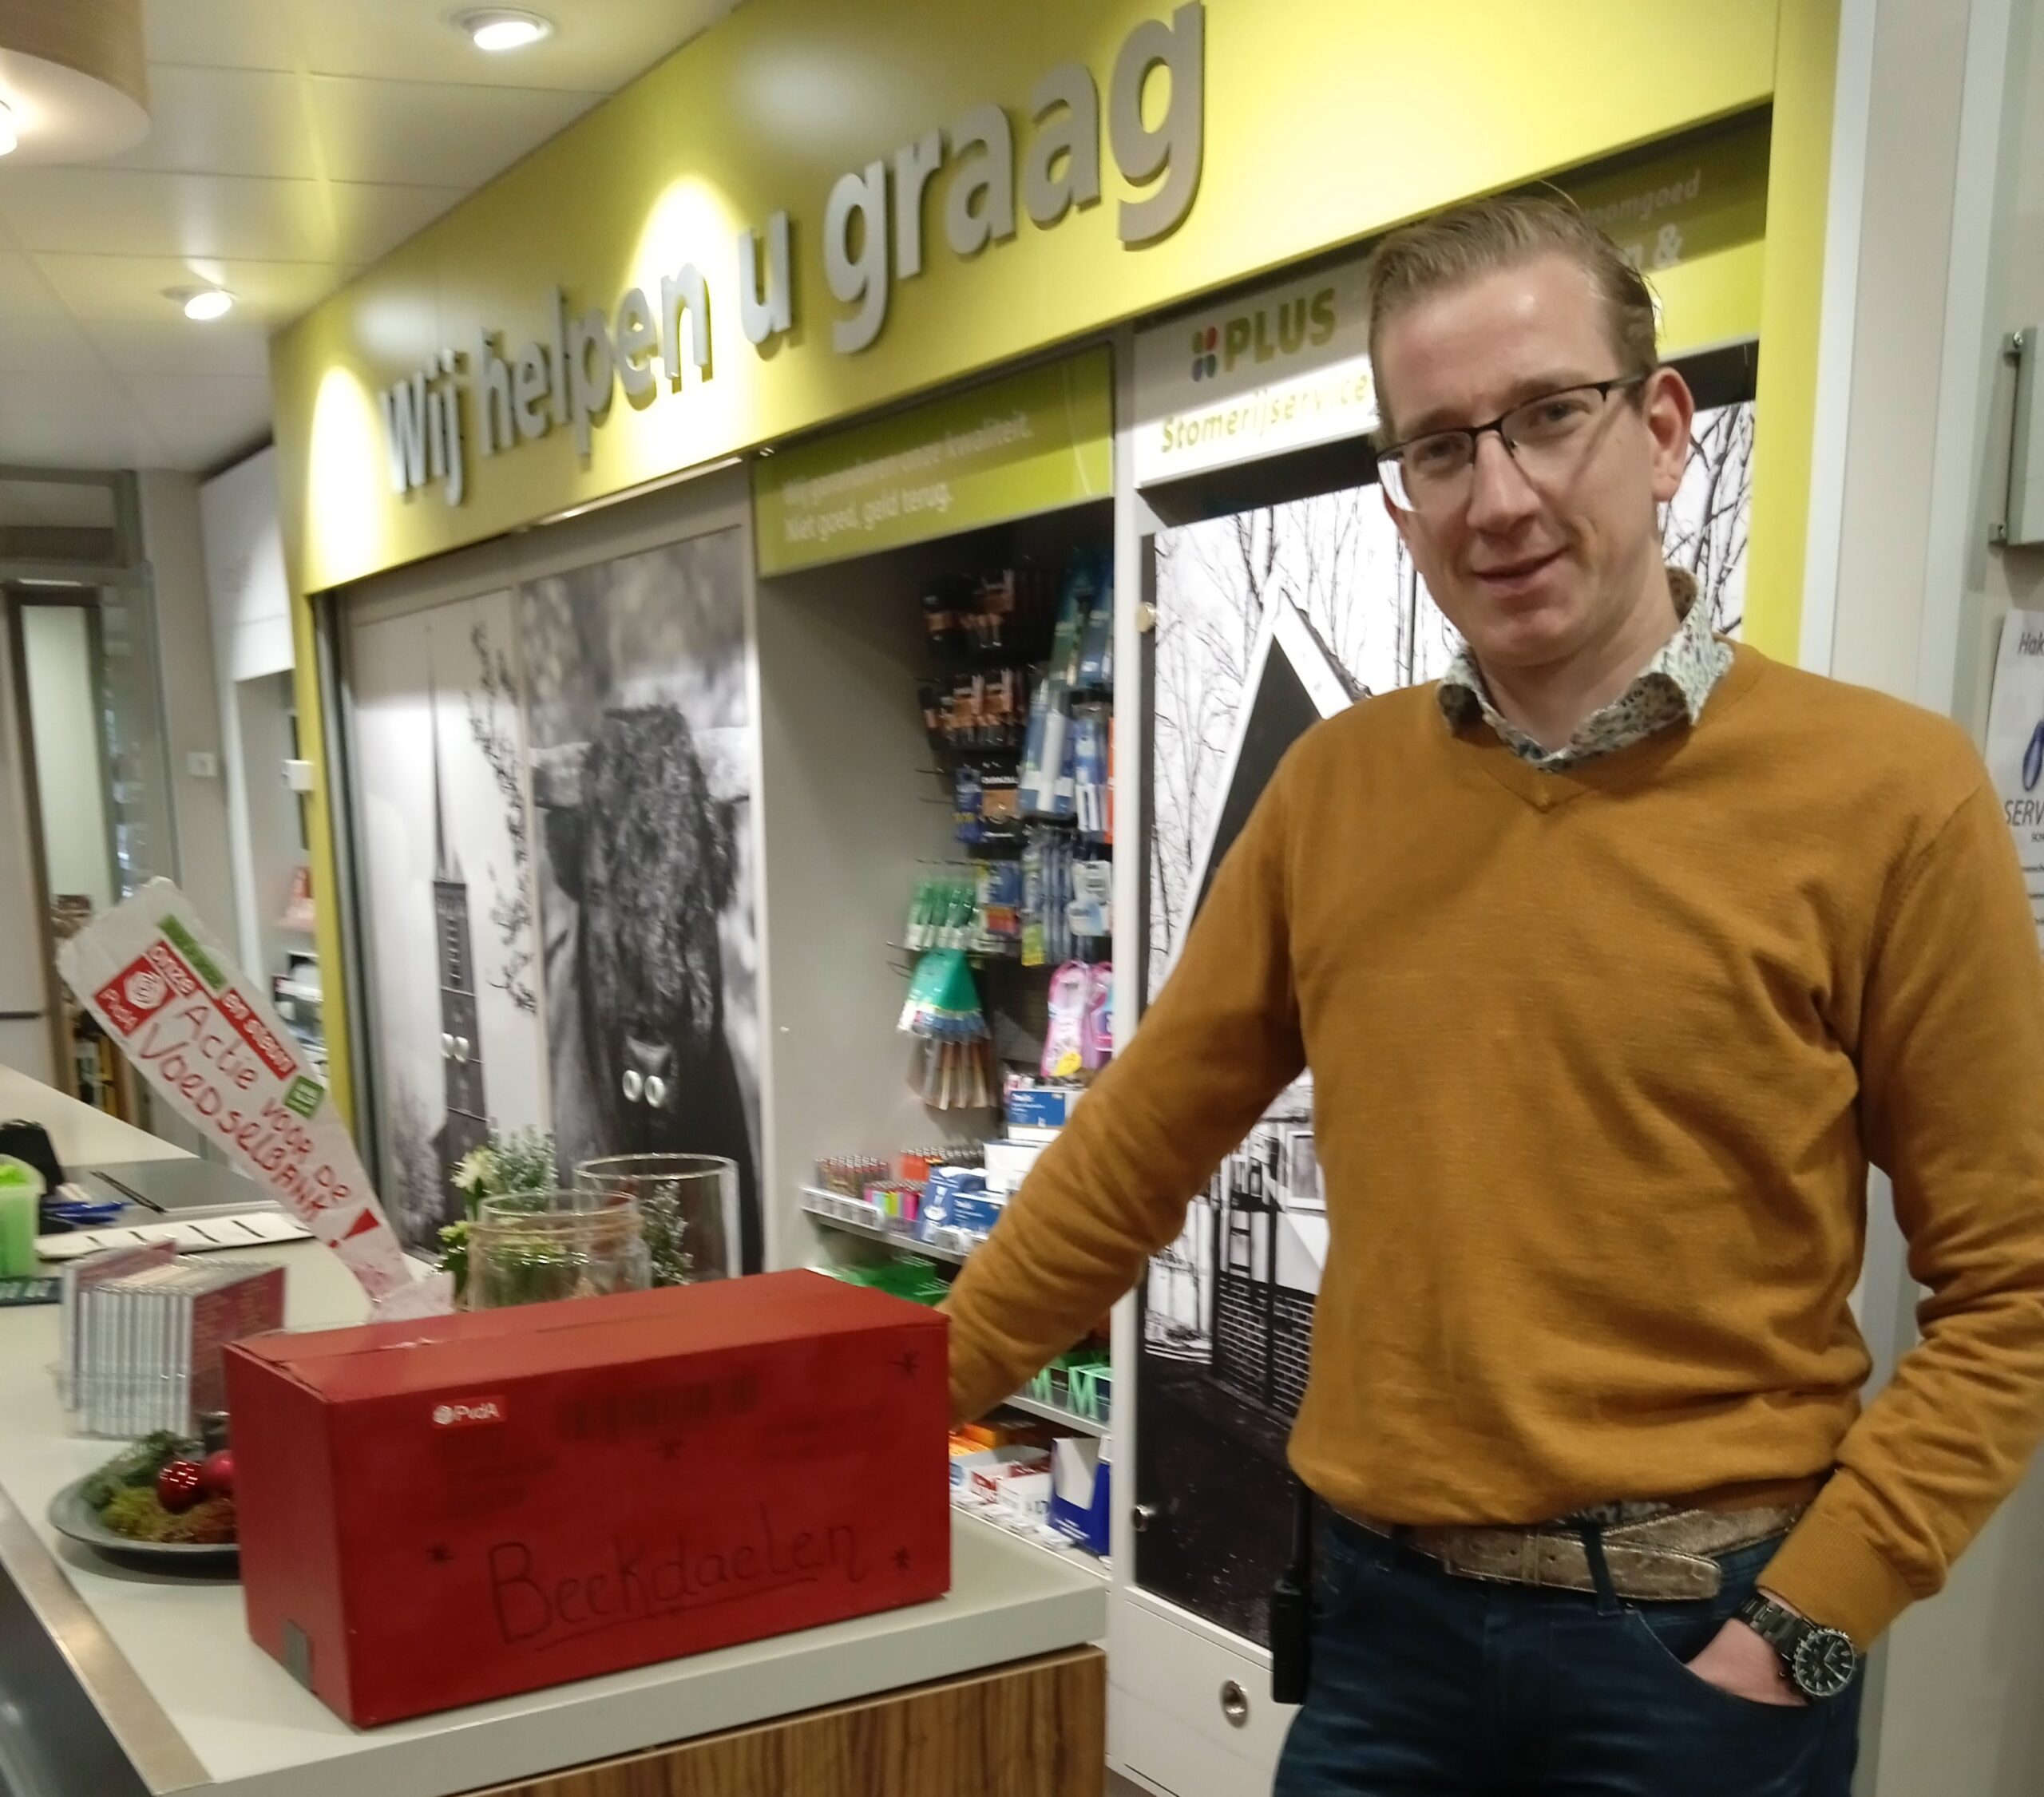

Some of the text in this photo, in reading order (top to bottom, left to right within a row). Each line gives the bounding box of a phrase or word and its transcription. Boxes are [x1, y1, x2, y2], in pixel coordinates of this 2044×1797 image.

[379, 2, 1205, 507] Wij helpen u graag
[1223, 287, 1335, 373] PLUS
[1161, 374, 1369, 453] Stomerijservce
[174, 1004, 258, 1090] Actie
[487, 1502, 868, 1645] Beekdaelen
